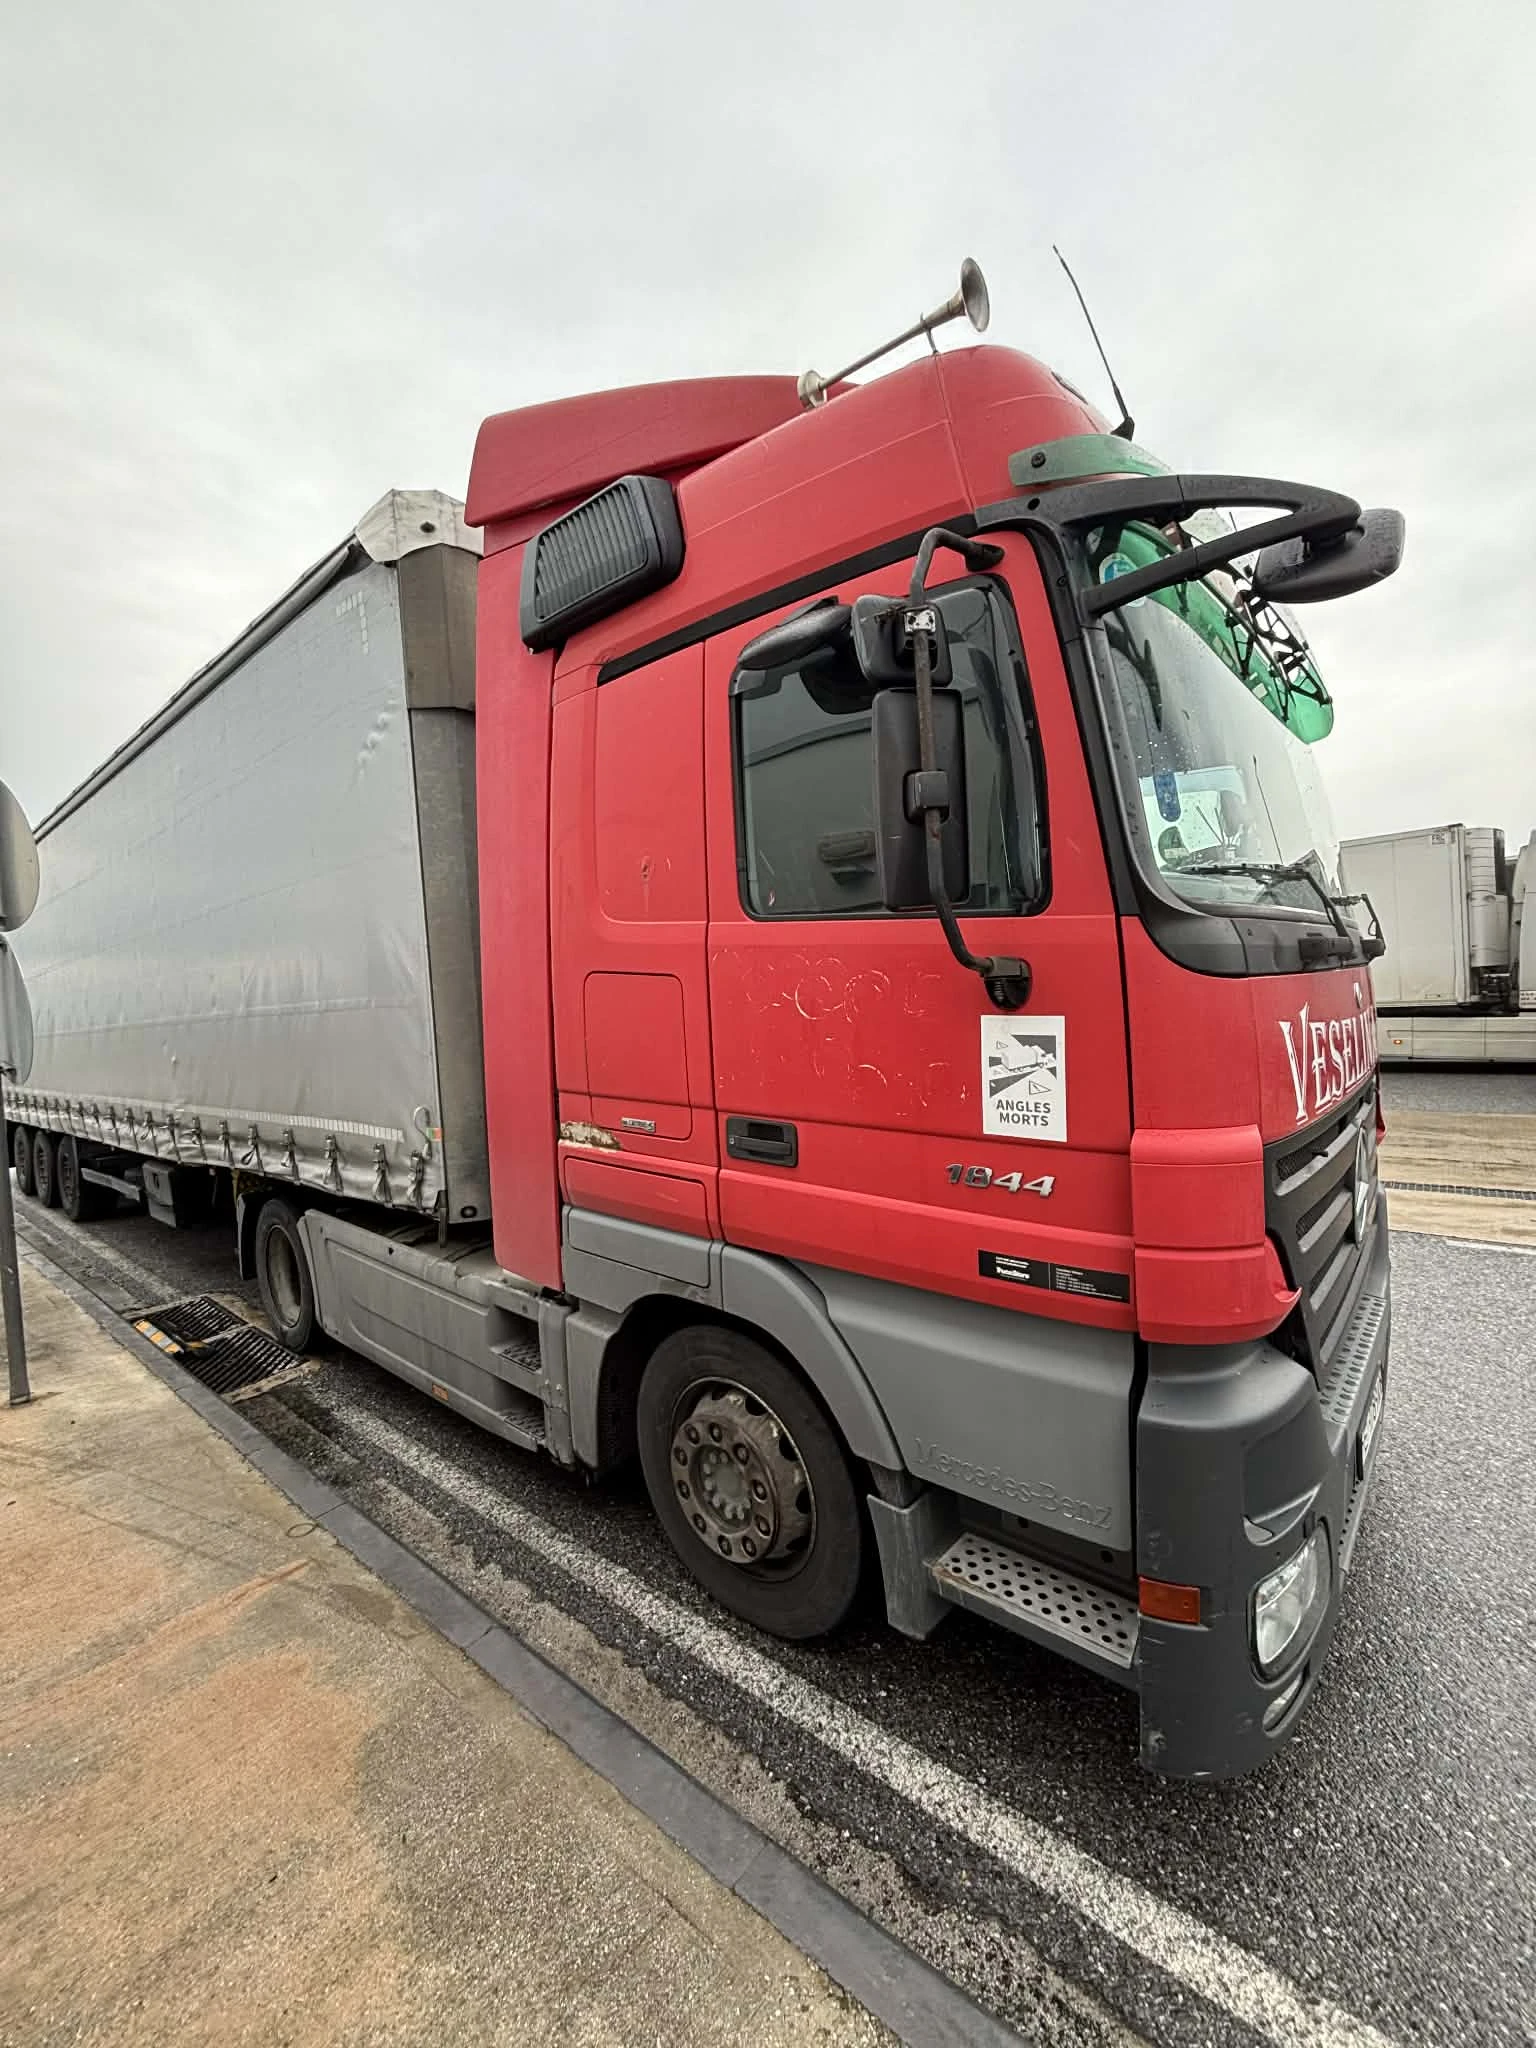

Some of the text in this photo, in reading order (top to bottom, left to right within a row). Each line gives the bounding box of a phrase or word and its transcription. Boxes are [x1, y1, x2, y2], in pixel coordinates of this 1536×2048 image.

[996, 1099, 1051, 1114] ANGLES
[999, 1112, 1049, 1127] MORTS
[945, 1163, 1057, 1197] 1844
[912, 1437, 1113, 1530] Mercedes-Benz
